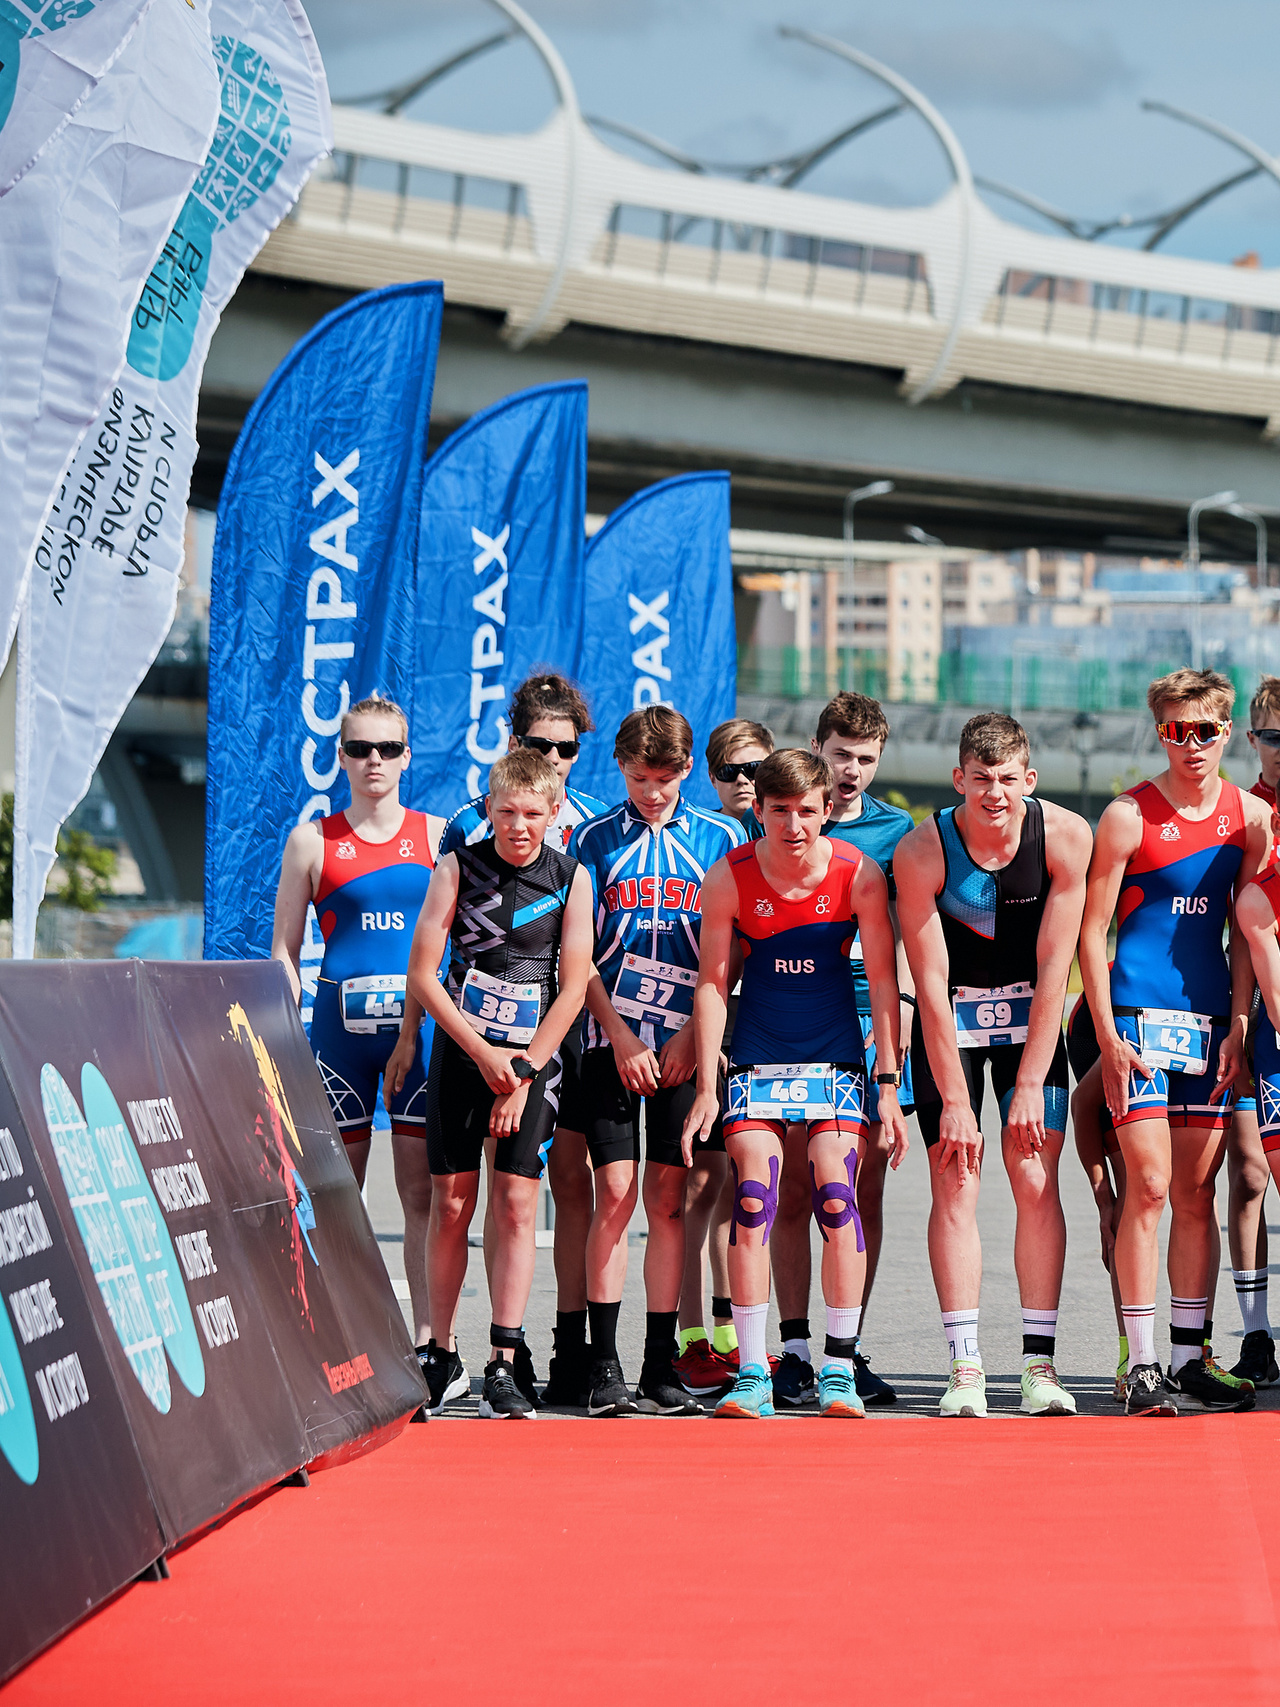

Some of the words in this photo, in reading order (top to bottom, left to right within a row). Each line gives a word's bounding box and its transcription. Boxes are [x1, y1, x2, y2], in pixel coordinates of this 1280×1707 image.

[603, 876, 702, 914] RUSSI
[1171, 896, 1208, 915] RUS
[361, 912, 406, 931] RUS
[774, 958, 816, 975] RUS
[364, 993, 402, 1017] 44
[635, 977, 676, 1008] 37
[478, 993, 519, 1025] 38
[975, 1001, 1012, 1028] 69
[1160, 1026, 1192, 1055] 42
[769, 1079, 809, 1102] 46
